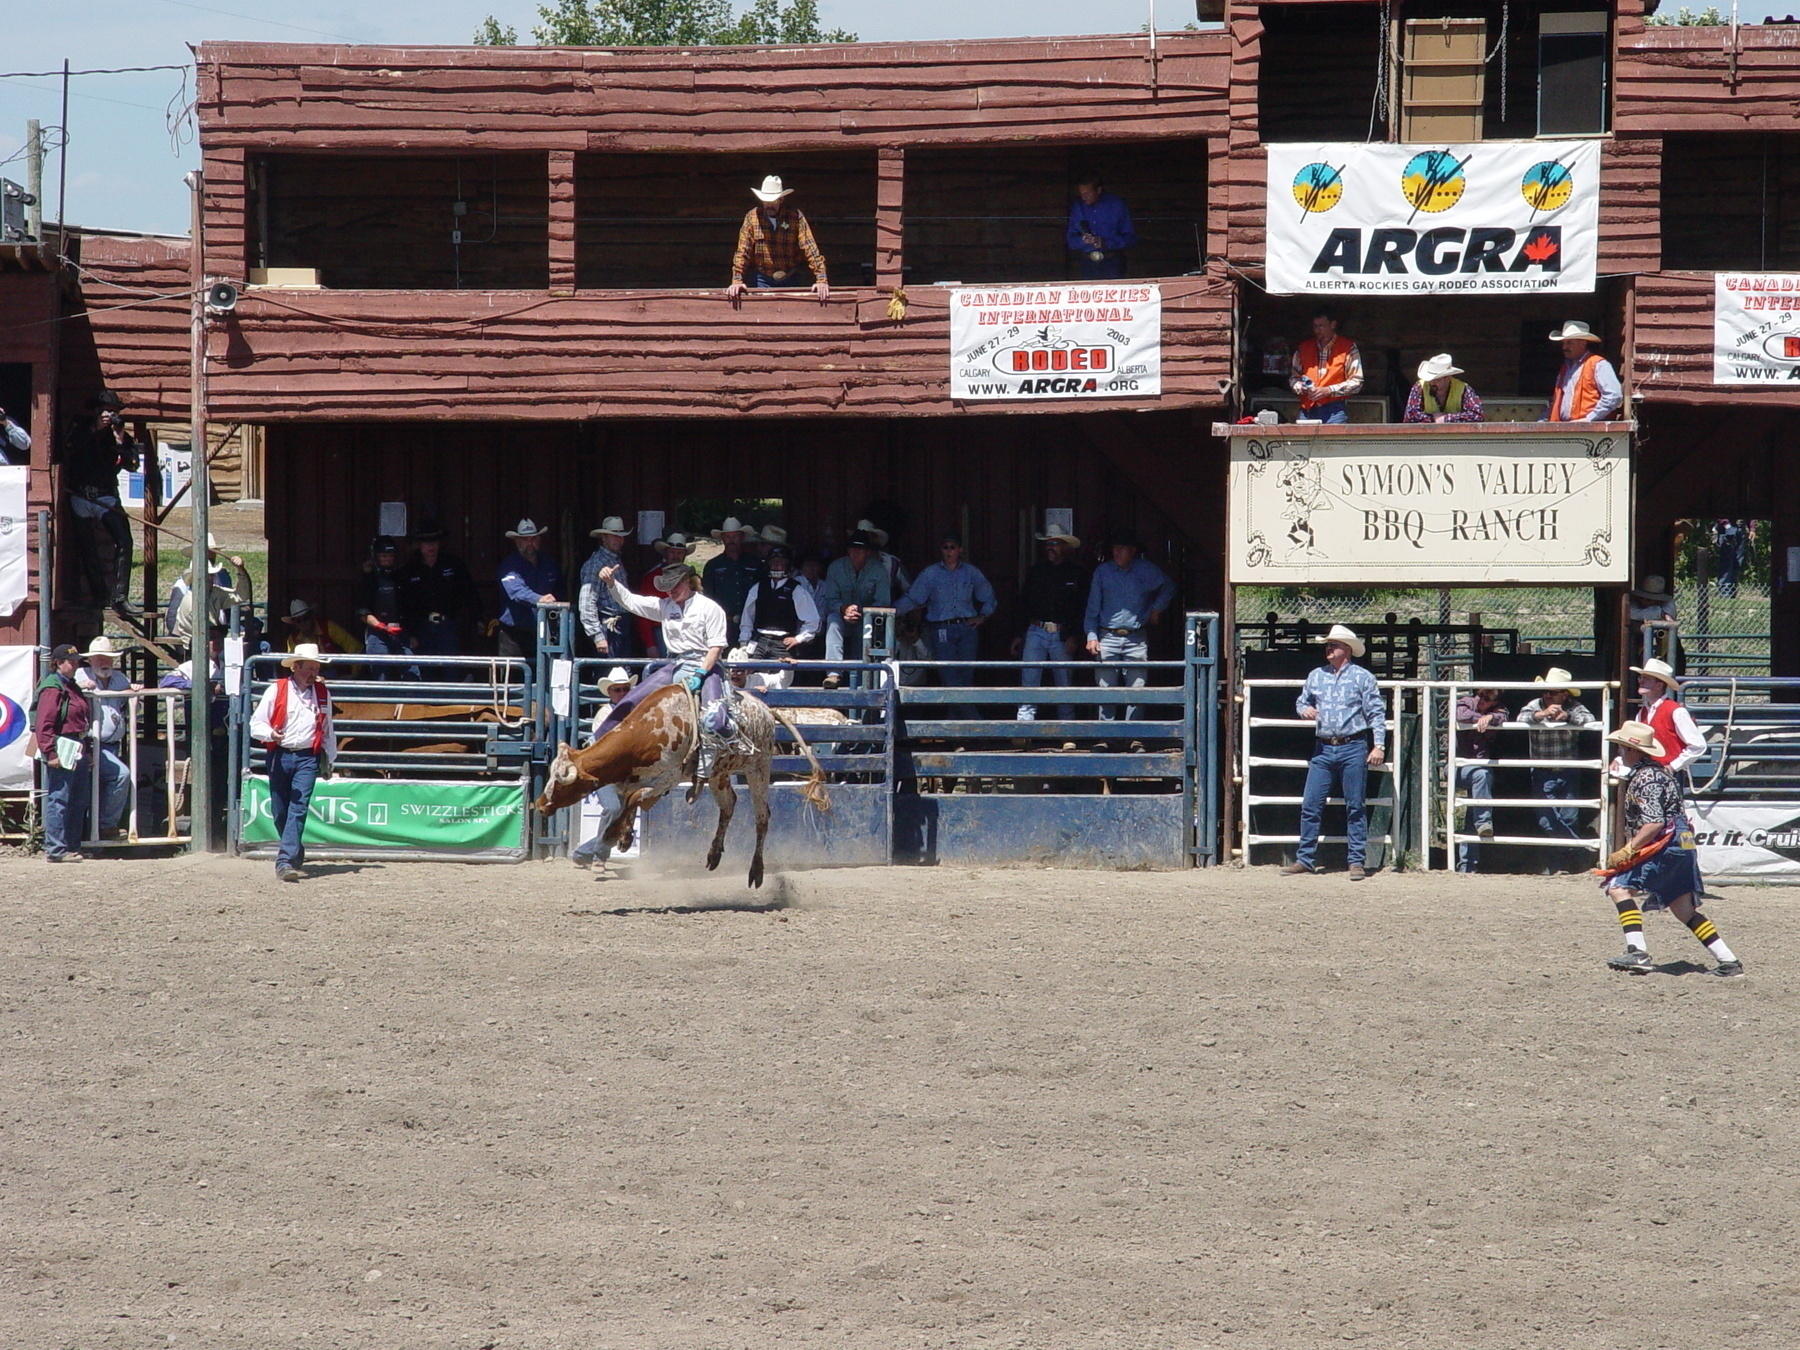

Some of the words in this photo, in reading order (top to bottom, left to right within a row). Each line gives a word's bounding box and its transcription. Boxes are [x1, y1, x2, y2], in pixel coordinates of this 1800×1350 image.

[1309, 225, 1562, 275] ARGRA
[1305, 280, 1355, 290] ALBERTA
[1359, 280, 1409, 290] ROCKIES
[1412, 280, 1435, 290] GAY
[1438, 279, 1477, 290] RODEO
[1481, 278, 1558, 288] ASSOCIATION
[960, 291, 1061, 307] CANADIAN
[1068, 288, 1150, 303] ROCKIES
[978, 307, 1133, 325] INTERNATIONAL
[1106, 327, 1131, 346] '2003
[1736, 330, 1758, 347] JUNE
[1759, 322, 1772, 334] 27
[1779, 312, 1792, 324] 29
[966, 345, 988, 363] JUNE
[988, 337, 1000, 349] 27
[1007, 326, 1020, 338] 29
[1012, 349, 1107, 372] RODEO
[1728, 352, 1760, 360] CALGARY
[960, 368, 991, 378] CALGARY
[1117, 364, 1148, 375] ALBERTA
[1017, 378, 1097, 394] ARGRA
[1341, 463, 1454, 495] SYMON'S
[1476, 462, 1576, 494] VALLEY
[1363, 509, 1424, 548] BBQ
[1452, 509, 1559, 541] RANCH
[863, 624, 872, 638] 2
[1187, 630, 1195, 645] 3
[244, 789, 358, 827] JNTS
[401, 804, 524, 817] SWIZZLESTICKS
[1694, 830, 1719, 846] et
[1722, 830, 1744, 847] it.
[1749, 828, 1800, 847] Crui
